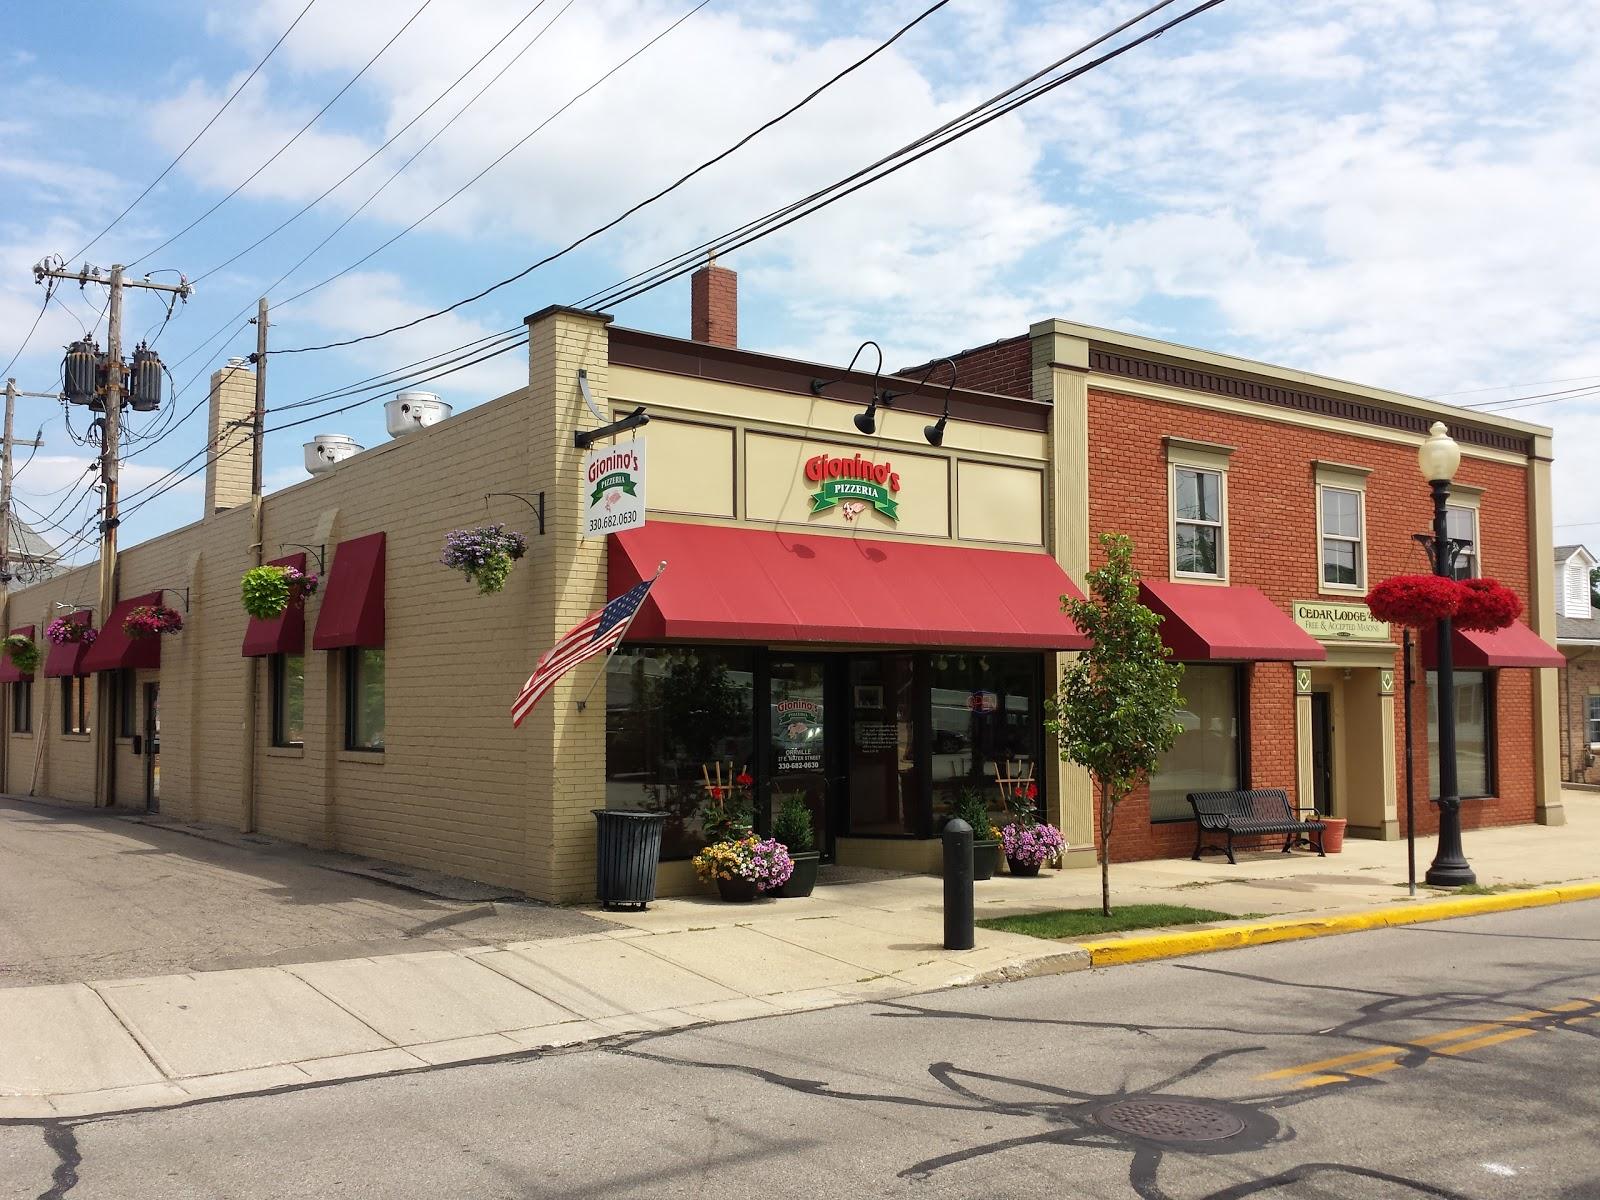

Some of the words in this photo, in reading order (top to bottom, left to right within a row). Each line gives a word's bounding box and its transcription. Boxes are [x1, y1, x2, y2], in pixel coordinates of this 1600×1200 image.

[588, 449, 638, 483] Gionino's
[805, 453, 901, 492] Gionino's
[601, 476, 626, 488] PIZZERIA
[834, 484, 879, 498] PIZZERIA
[589, 510, 637, 532] 330.682.0630
[1299, 606, 1334, 622] CEDAR
[1334, 609, 1367, 622] LODGE
[1304, 620, 1319, 630] FREE
[1320, 621, 1328, 632] &
[1328, 622, 1356, 631] ACCEPTED
[1357, 623, 1380, 633] MASONS
[777, 699, 818, 714] Gionino's
[778, 761, 820, 770] 330-682-0630
